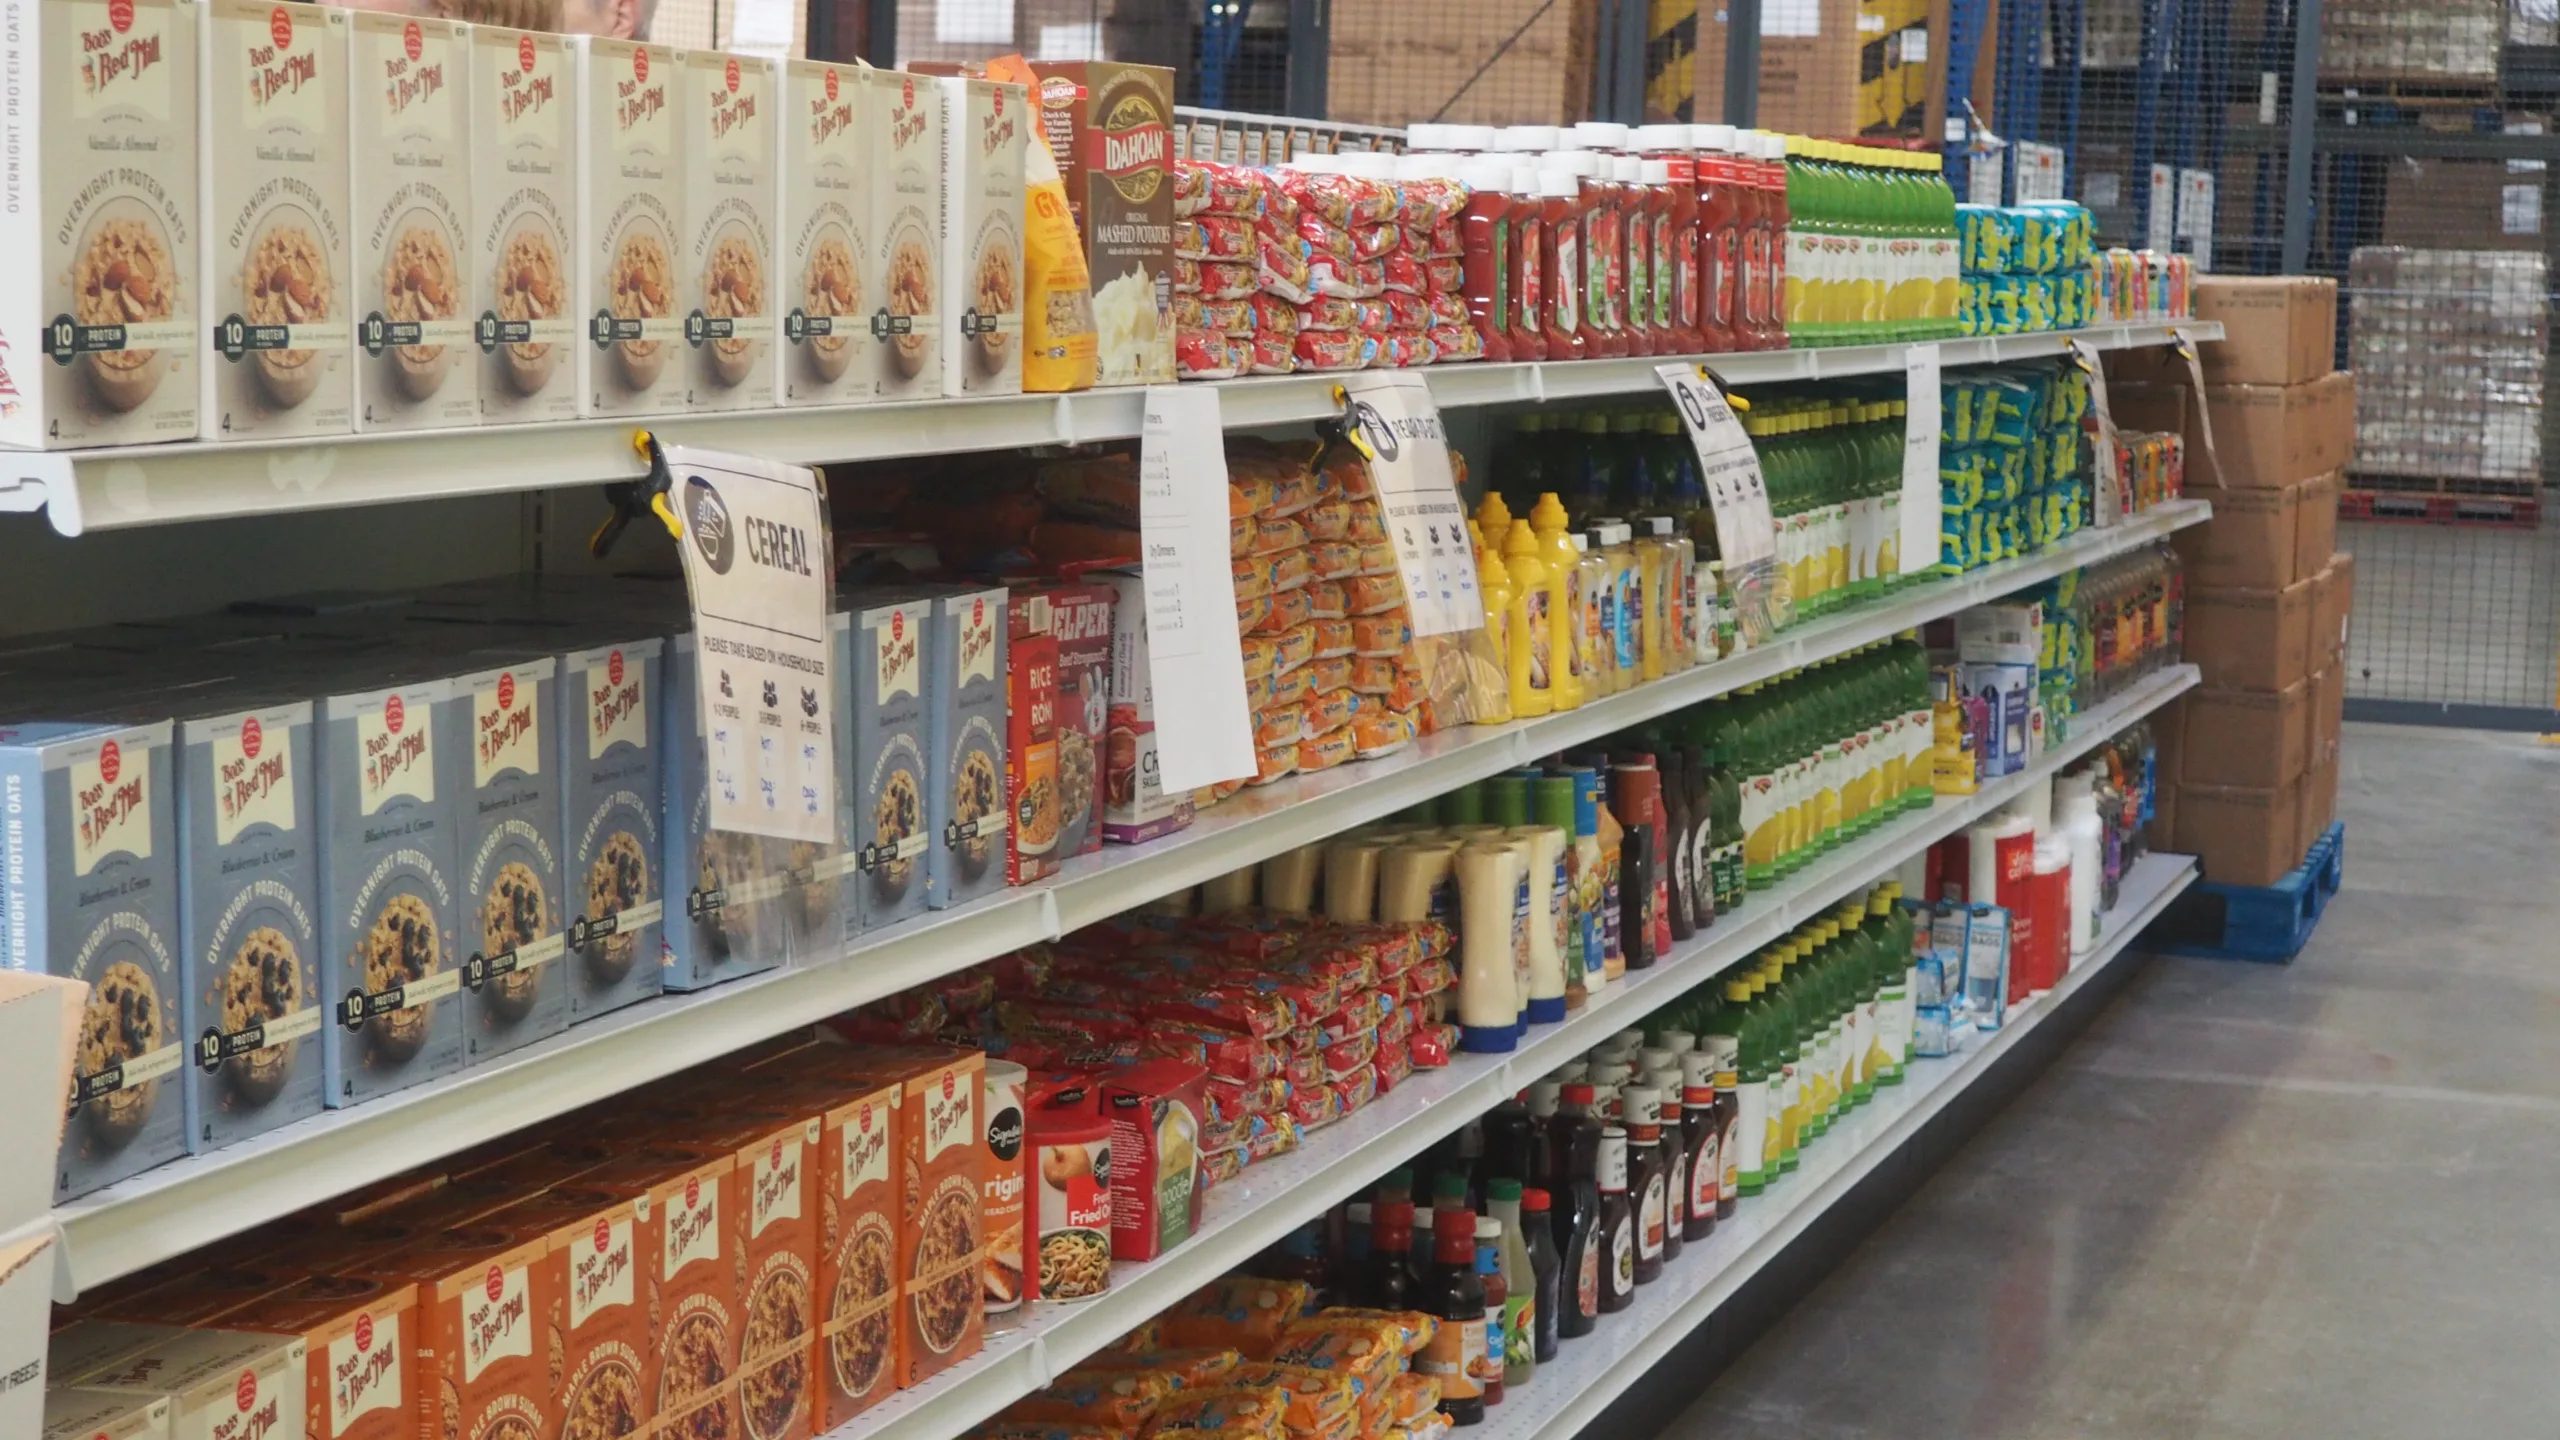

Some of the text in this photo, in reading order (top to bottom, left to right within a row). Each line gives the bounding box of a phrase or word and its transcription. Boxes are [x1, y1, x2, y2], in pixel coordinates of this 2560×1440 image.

[81, 29, 112, 53] Bob's
[249, 45, 275, 68] Bob's
[99, 34, 162, 92] Red Mill
[264, 51, 317, 105] Red Mill
[399, 63, 444, 114] Red Mill
[6, 2, 21, 214] OVERNIGHT PROTEIN OATS
[1105, 130, 1164, 171] IDAHOAN
[58, 167, 188, 247] OVERNIGHT PROTEIN OATS
[230, 176, 340, 251] OVERNIGHT PROTEIN OATS
[370, 181, 451, 250] OVERNIGHT PROTEIN
[486, 188, 525, 253] OVERNIGHT
[1097, 225, 1171, 244] MASHED POTATOES
[53, 323, 73, 347] 10
[88, 328, 122, 342] PROTEIN
[225, 322, 243, 345] 10
[255, 328, 286, 342] PROTEIN
[367, 320, 383, 340] 10
[393, 324, 418, 337] PROTEIN
[481, 319, 495, 339] 10
[597, 318, 610, 337] 10
[691, 316, 704, 334] 10
[50, 418, 59, 441] 4
[221, 412, 231, 433] 4
[746, 515, 812, 577] CEREAL
[704, 636, 825, 676] PLEASE TAKE BASED ON HOUSEHOLD SIZE
[1030, 665, 1052, 690] RICE
[602, 681, 641, 735] Red Mill
[1031, 701, 1053, 726] RONI
[366, 732, 389, 757] Bob's
[490, 704, 533, 758] Red Mill
[221, 757, 245, 784] Bob's
[380, 729, 426, 789] Red Mill
[6, 774, 22, 811] OATS
[235, 752, 286, 818] Red Mill
[94, 774, 143, 846] Red Mill
[579, 796, 615, 862] OVERNIGHT
[8, 815, 24, 884] PROTEIN
[470, 819, 537, 896] OVERNIGHT PROTEIN
[350, 849, 433, 929] OVERNIGHT PROTEIN
[208, 880, 313, 964] OVERNIGHT PROTEIN OATS
[574, 922, 586, 941] 10
[71, 911, 171, 981] ERNIGHT PROTEIN OATS
[470, 953, 515, 980] 10 PROTEIN
[347, 987, 401, 1017] 10 PROTEIN
[203, 1028, 262, 1057] 10 PROTEIN
[91, 1068, 120, 1090] PROTEIN
[984, 1171, 1024, 1202] rigin
[679, 1200, 715, 1260] Red Mill
[1071, 1209, 1101, 1226] Fried
[577, 1255, 597, 1280] Bob's
[588, 1243, 629, 1303] Red Mill
[469, 1303, 490, 1330] Bob's
[482, 1288, 525, 1357] Red Mill
[660, 1293, 707, 1356] MAPLE BROWN
[9, 1358, 41, 1390] FREEZE
[337, 1354, 359, 1381] Bob's
[350, 1340, 395, 1412] Red Mill
[562, 1340, 642, 1409] MAPLE BROWN SUGAR
[486, 1394, 517, 1416] BROWN
[519, 1395, 543, 1429] SUGAR
